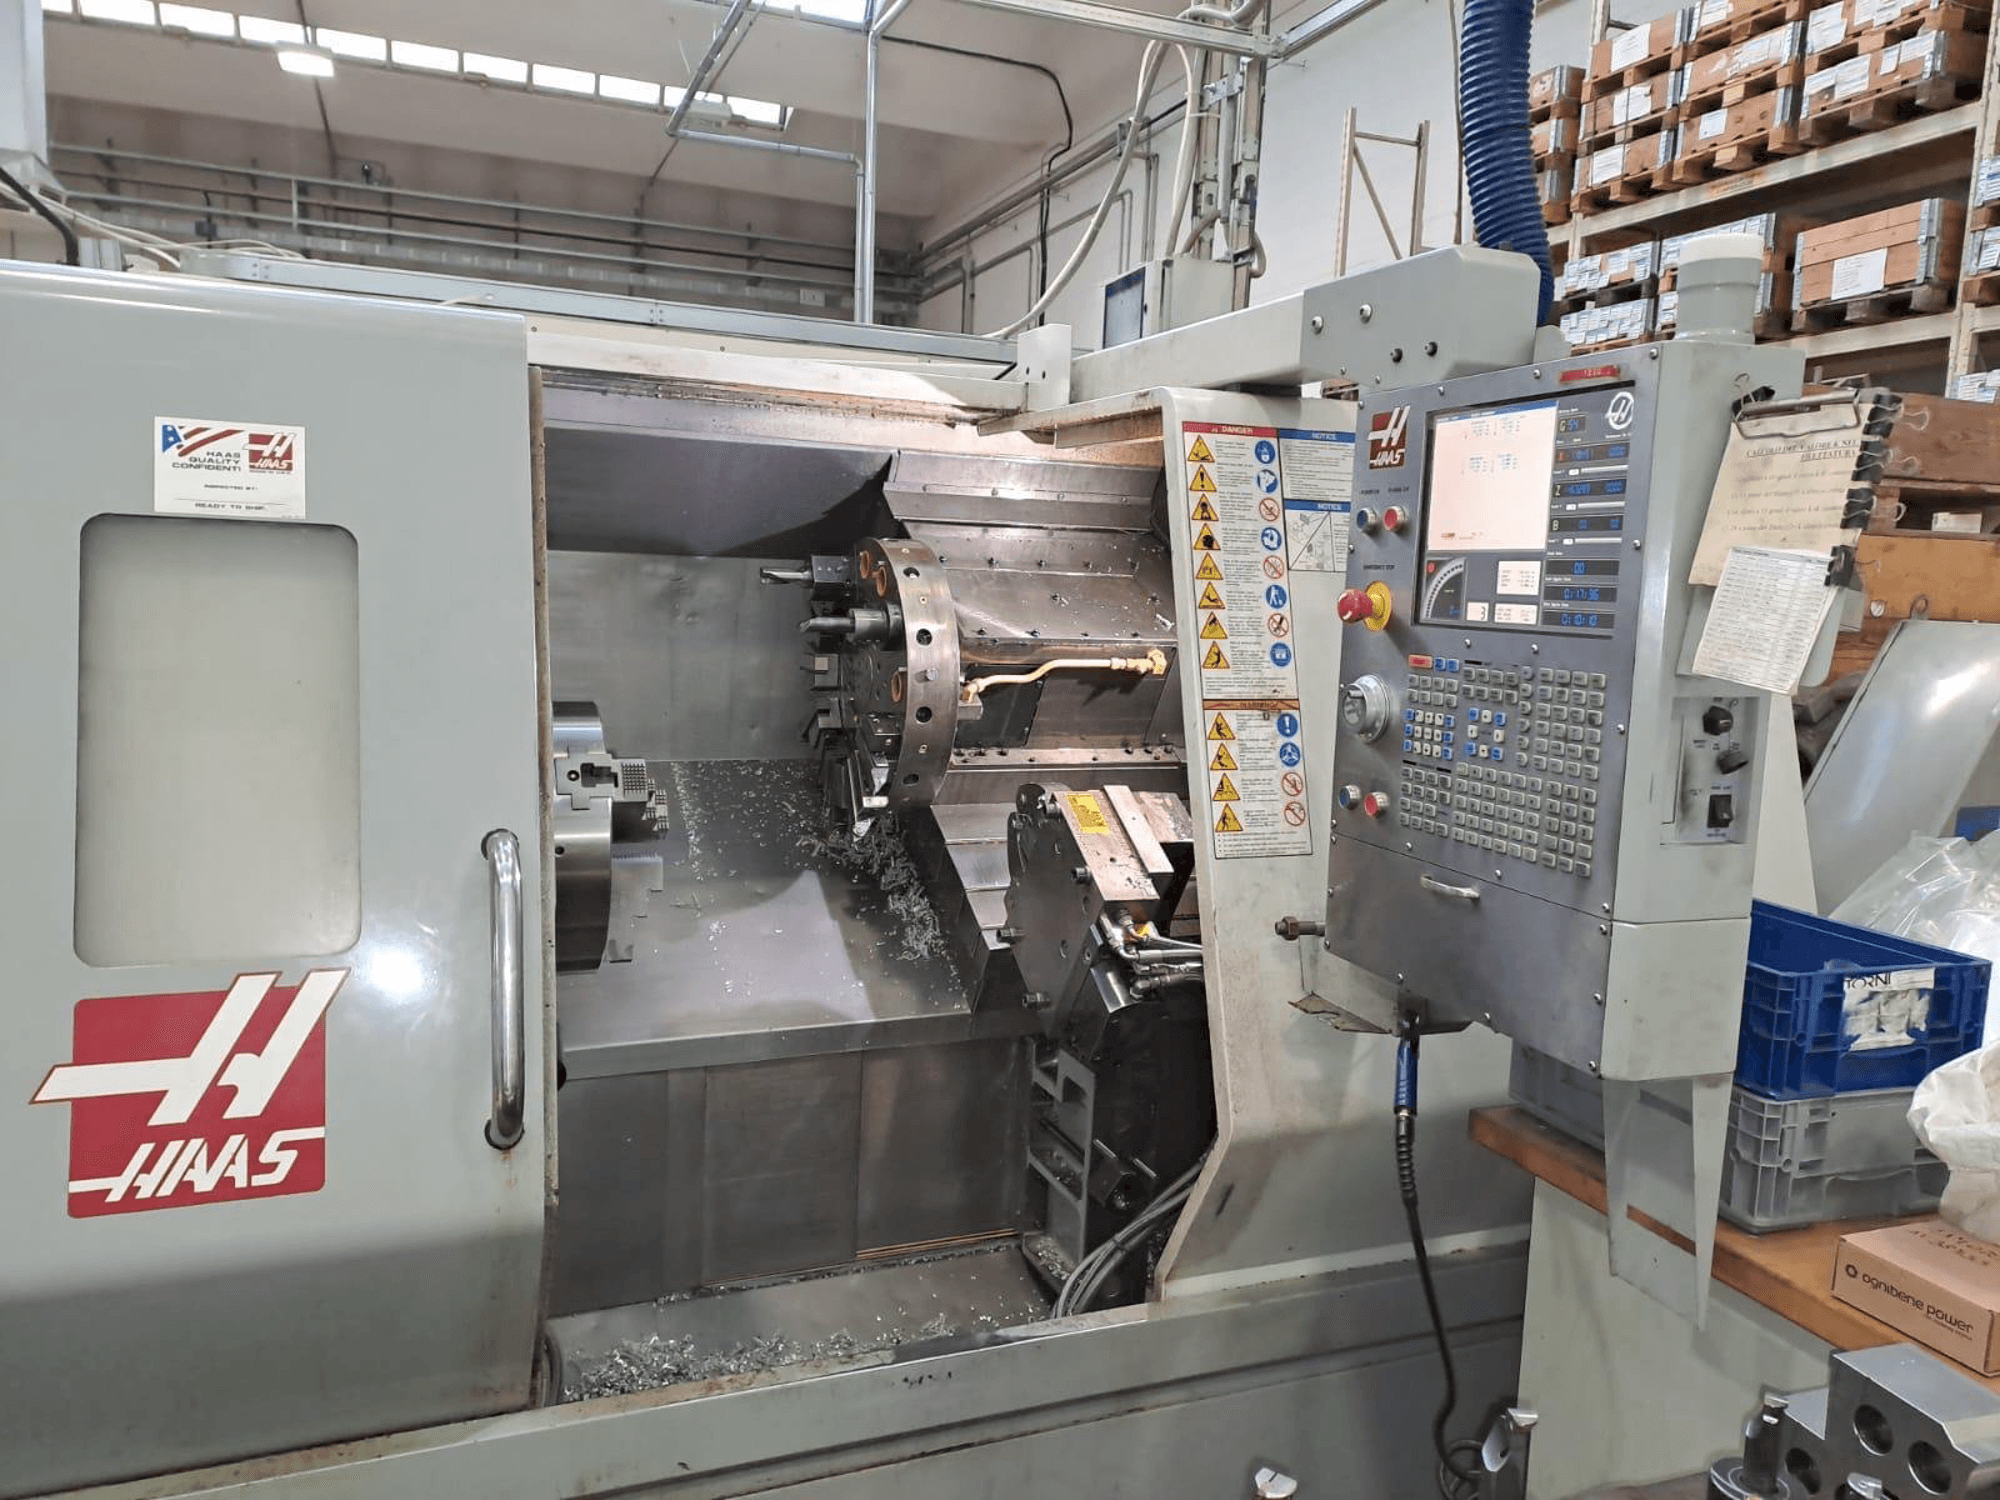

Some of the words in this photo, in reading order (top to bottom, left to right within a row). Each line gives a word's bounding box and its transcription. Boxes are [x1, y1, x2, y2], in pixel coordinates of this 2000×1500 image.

[189, 456, 241, 465] QUALITY
[249, 458, 293, 469] HAAS
[1370, 449, 1405, 466] HAAS
[1845, 972, 1891, 989] TORNI
[69, 1126, 326, 1203] HAAS
[1862, 1273, 1924, 1311] ognibene
[1926, 1304, 1974, 1334] power
